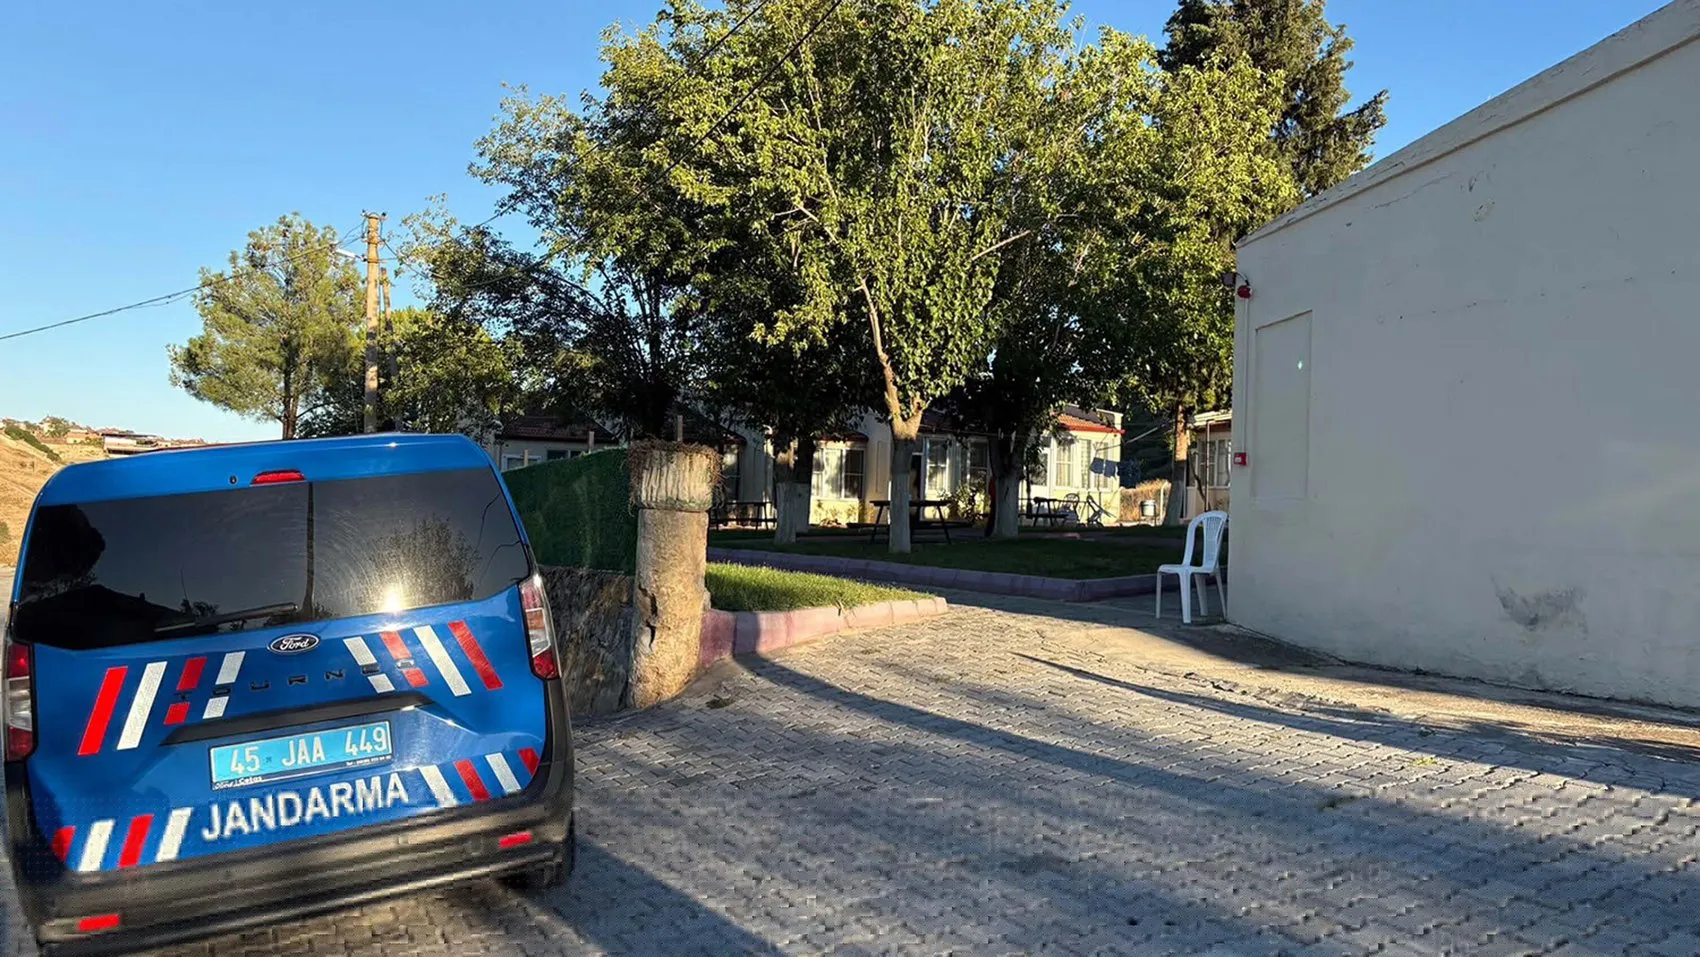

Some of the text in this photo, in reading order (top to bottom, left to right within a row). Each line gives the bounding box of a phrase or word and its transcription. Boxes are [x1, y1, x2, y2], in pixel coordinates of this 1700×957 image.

[279, 636, 310, 651] Ford
[230, 746, 260, 774] 45
[281, 736, 326, 766] JAA
[345, 727, 388, 756] 449
[202, 772, 409, 842] JANDARMA
